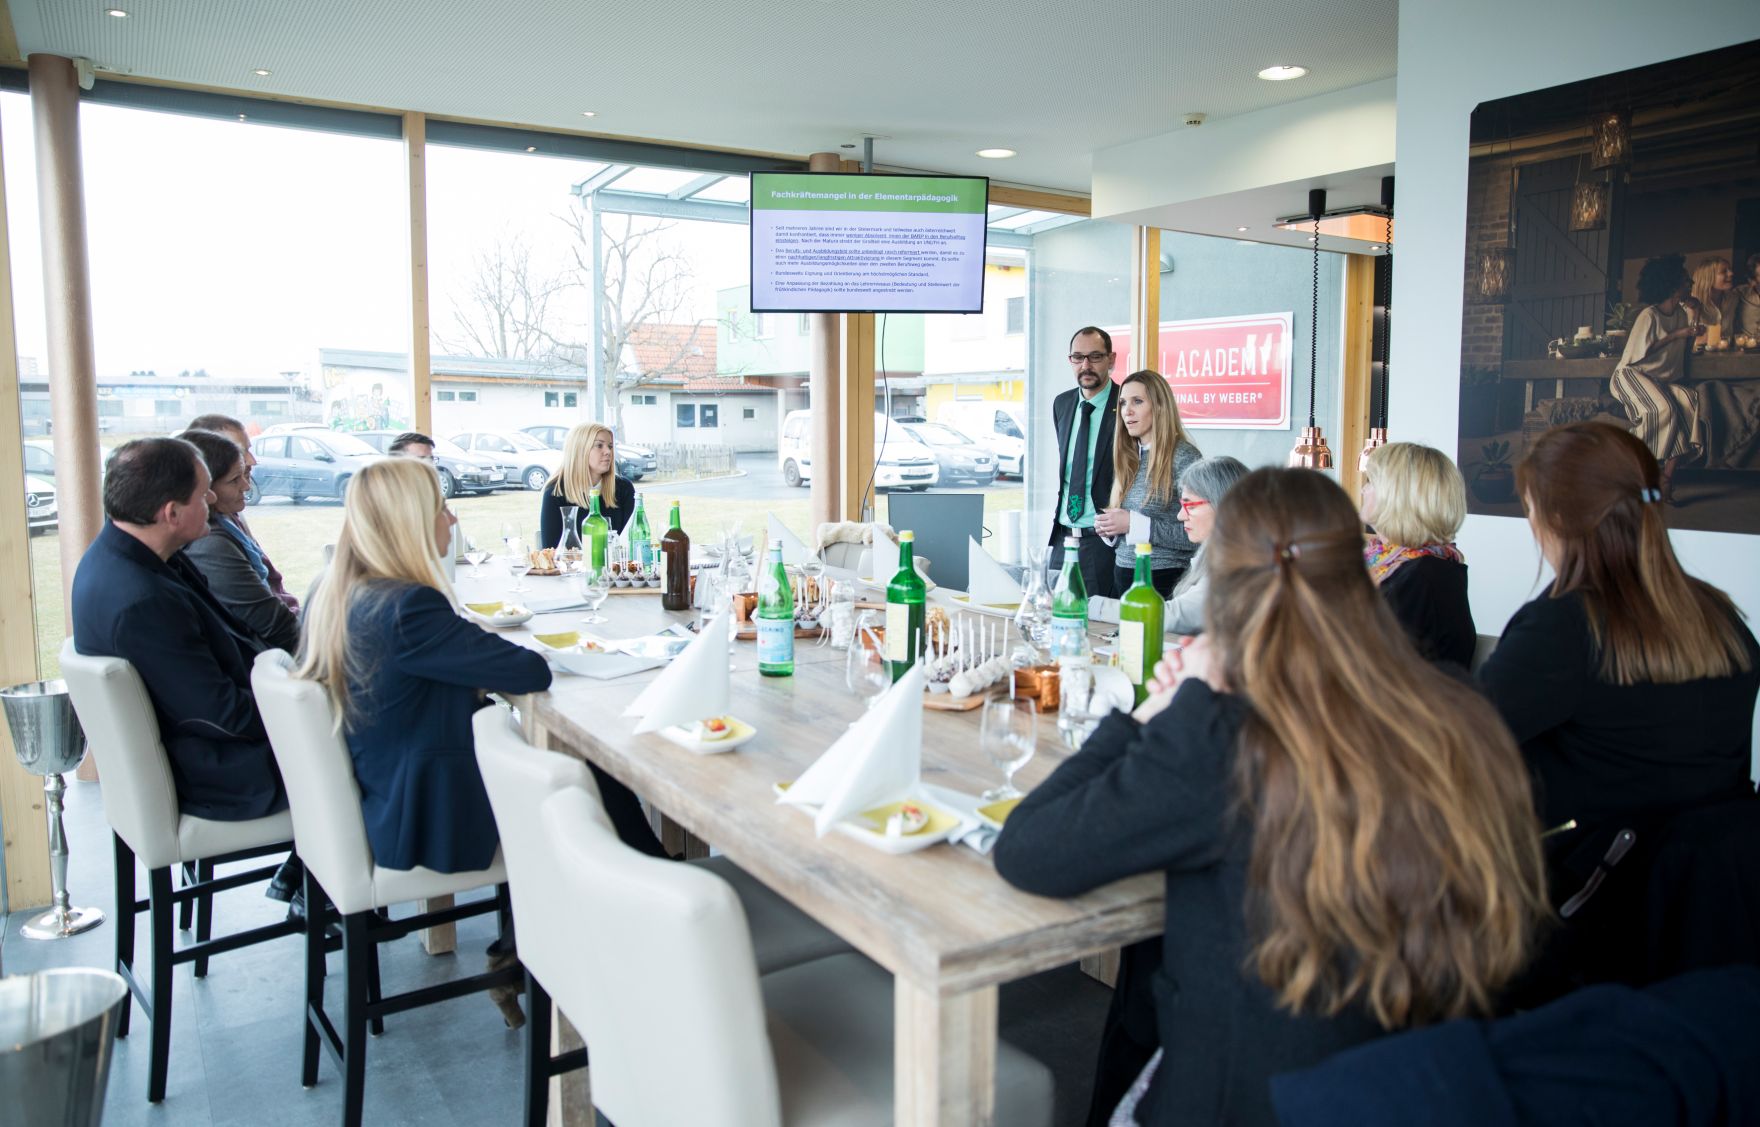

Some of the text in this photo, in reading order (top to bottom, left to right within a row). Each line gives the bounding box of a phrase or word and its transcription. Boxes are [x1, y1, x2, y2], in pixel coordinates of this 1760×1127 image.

[771, 191, 847, 200] Fachkräftemangel
[858, 192, 872, 200] der
[874, 192, 958, 202] Elementarpädagogik
[1175, 346, 1271, 378] ACADEMY
[1204, 393, 1216, 404] BY
